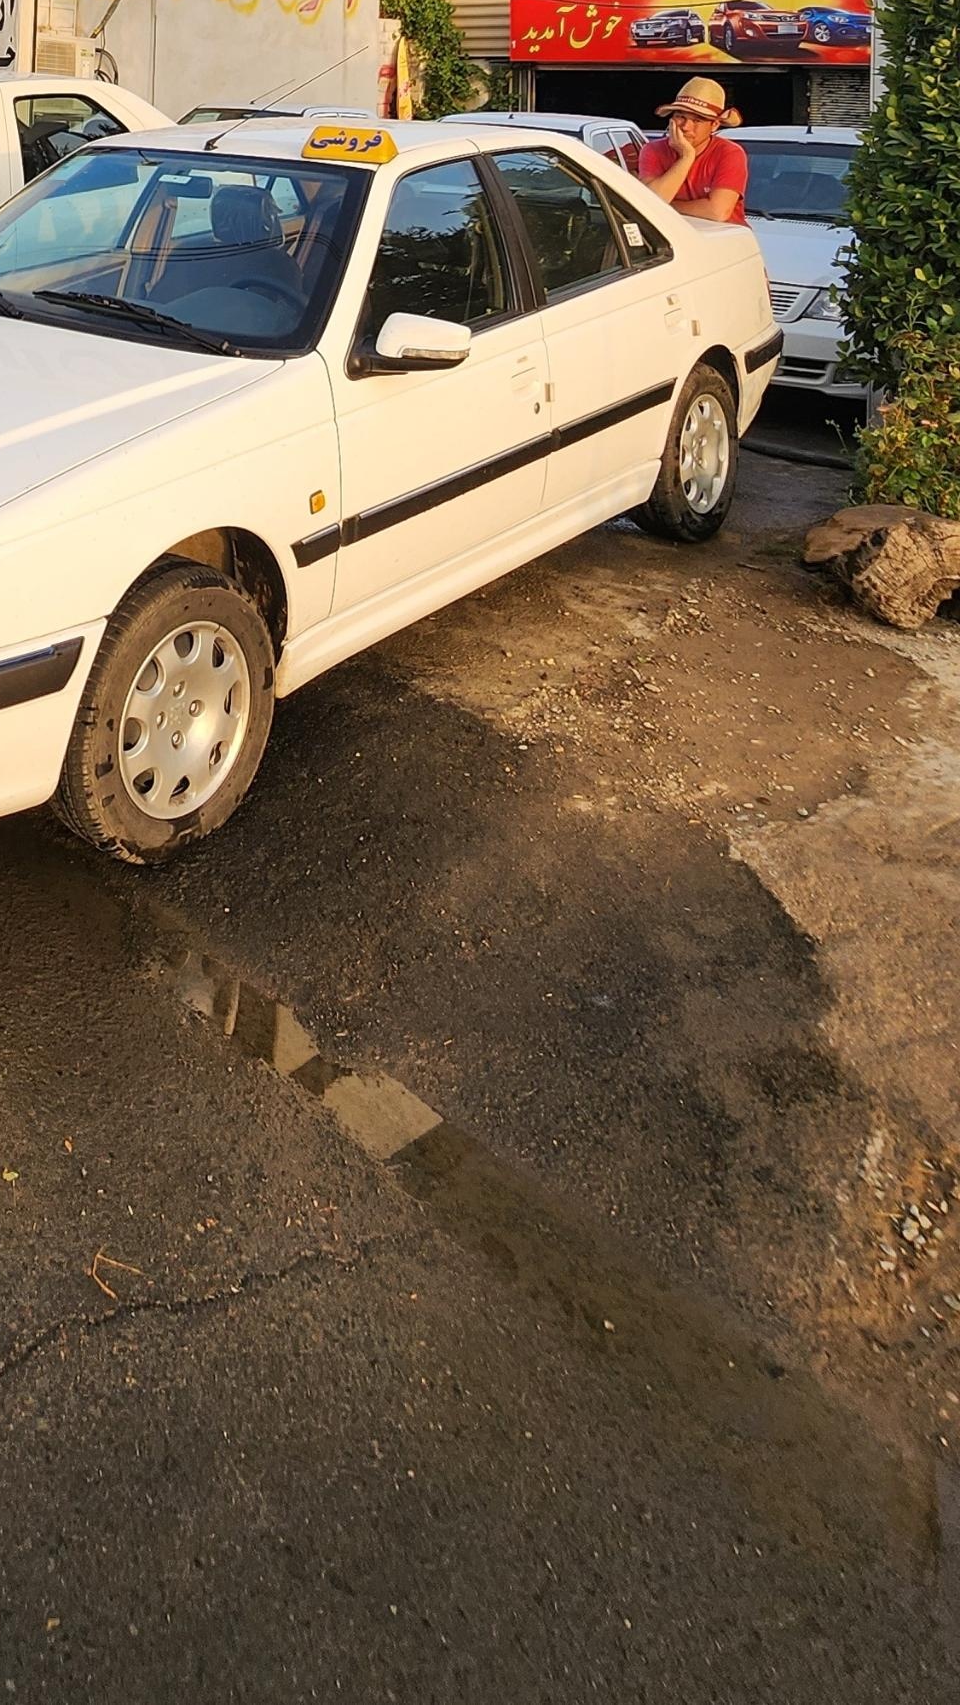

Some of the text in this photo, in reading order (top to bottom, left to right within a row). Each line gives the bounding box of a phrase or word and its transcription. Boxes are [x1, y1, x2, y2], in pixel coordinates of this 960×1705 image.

[521, 1, 624, 54] خوش آمدید
[310, 130, 382, 152] فروشی
